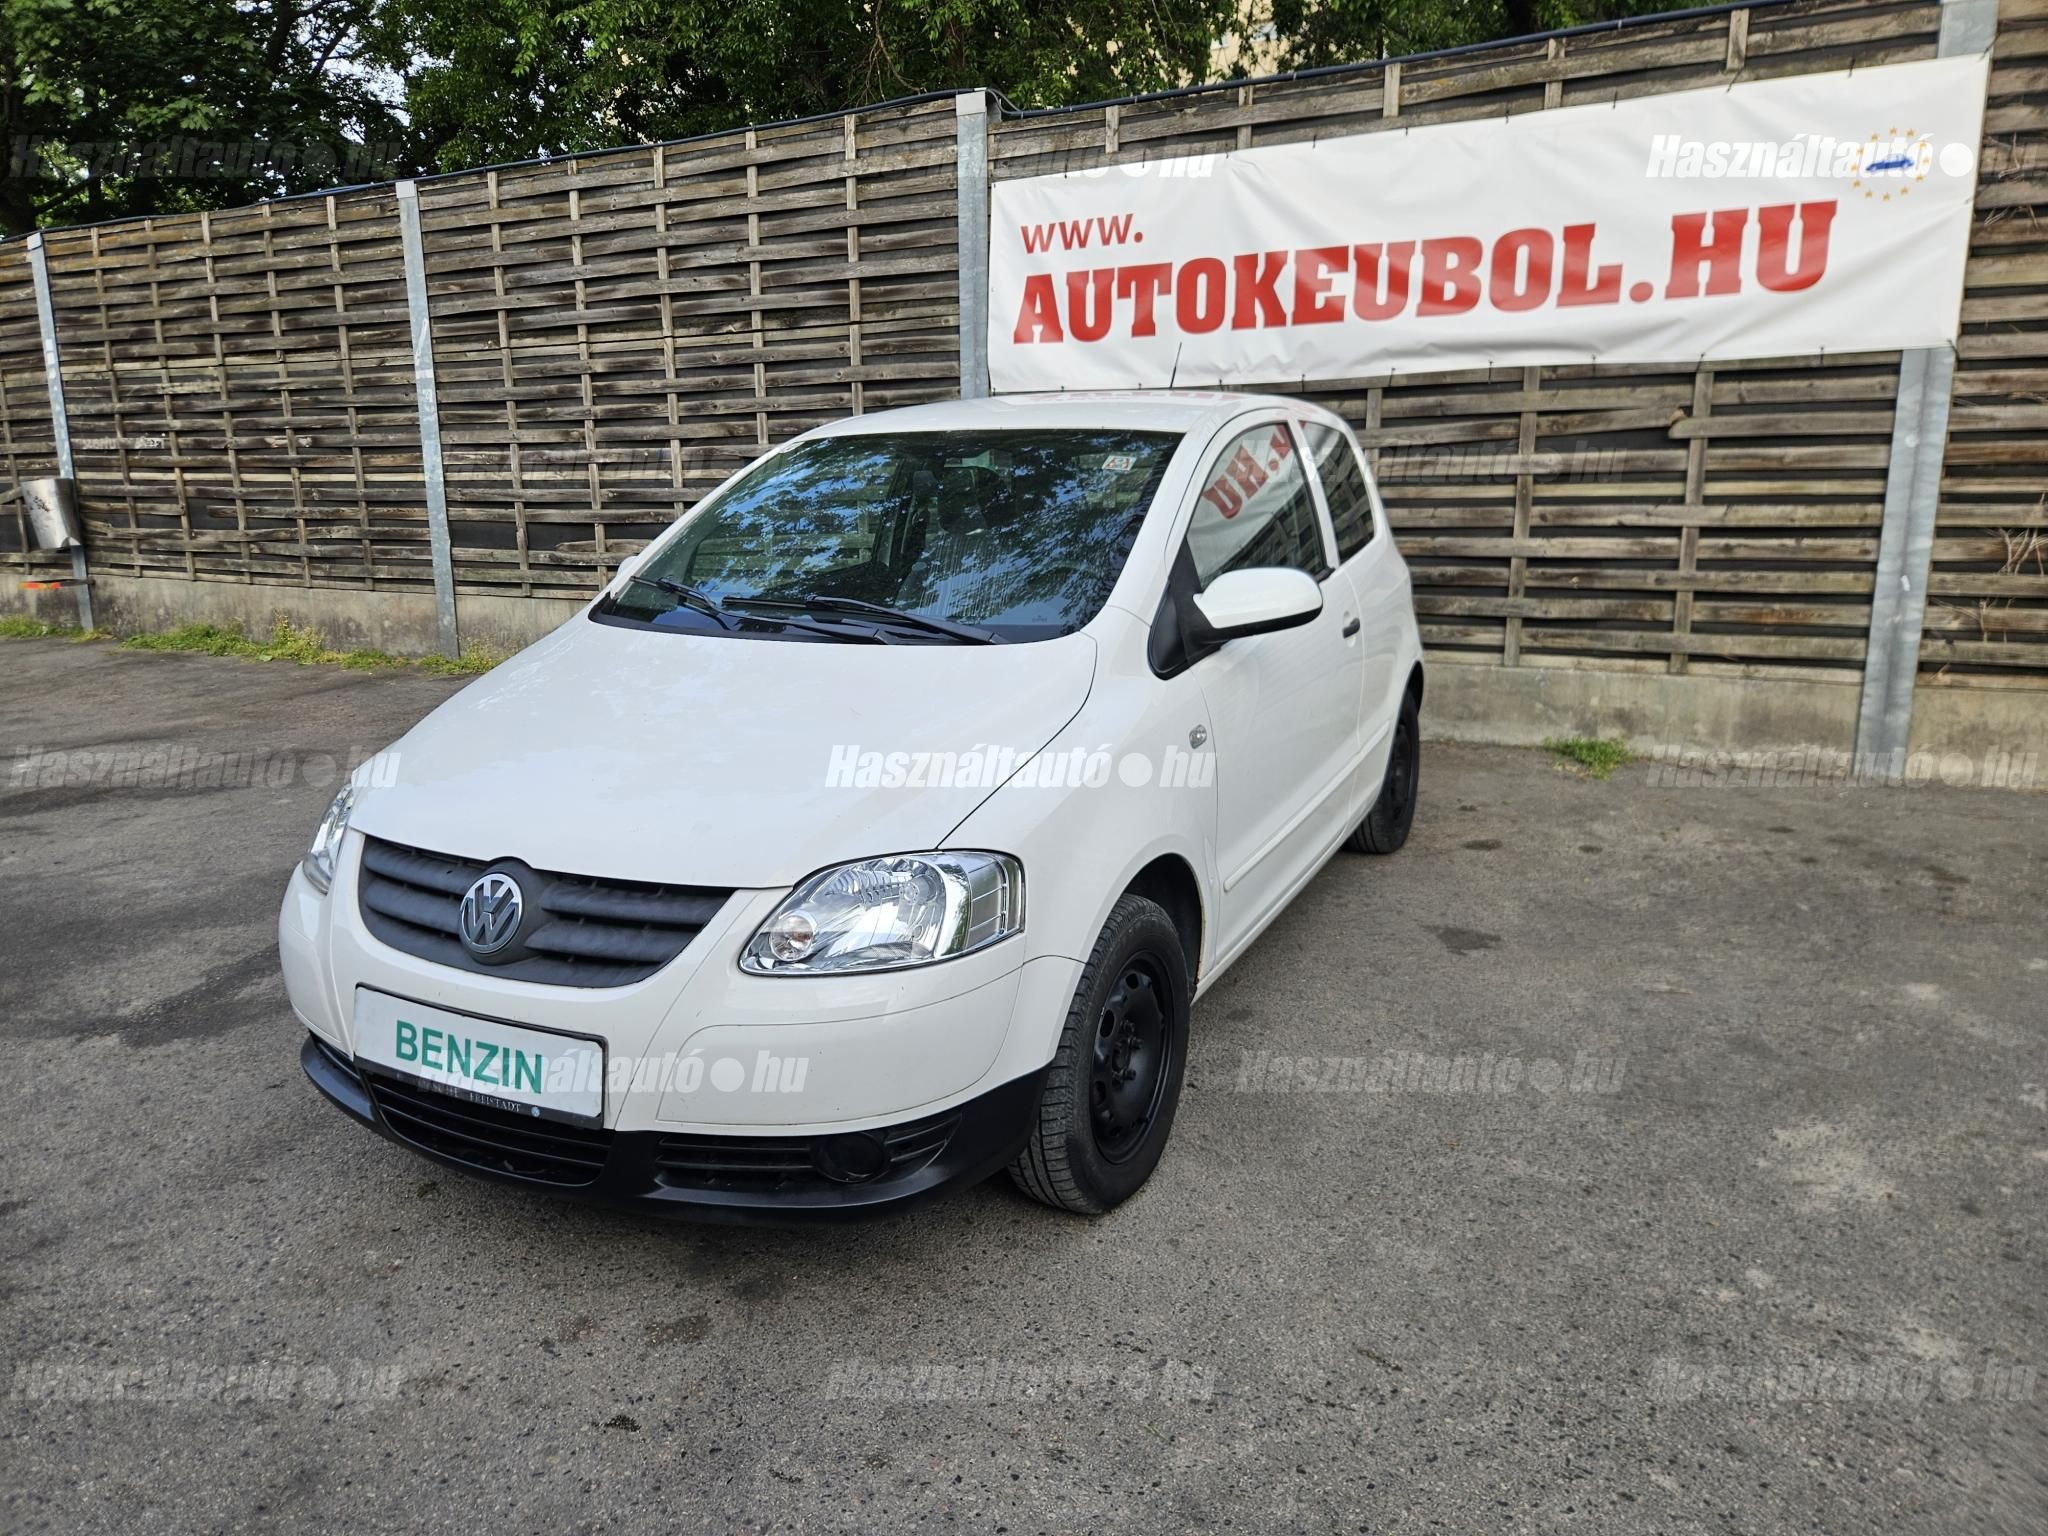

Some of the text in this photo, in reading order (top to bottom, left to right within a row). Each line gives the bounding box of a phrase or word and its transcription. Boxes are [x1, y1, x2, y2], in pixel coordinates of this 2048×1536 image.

[1020, 213, 1143, 254] www.
[1013, 199, 1837, 344] AUTOKEUBOL.HU
[396, 1020, 542, 1094] BENZIN
